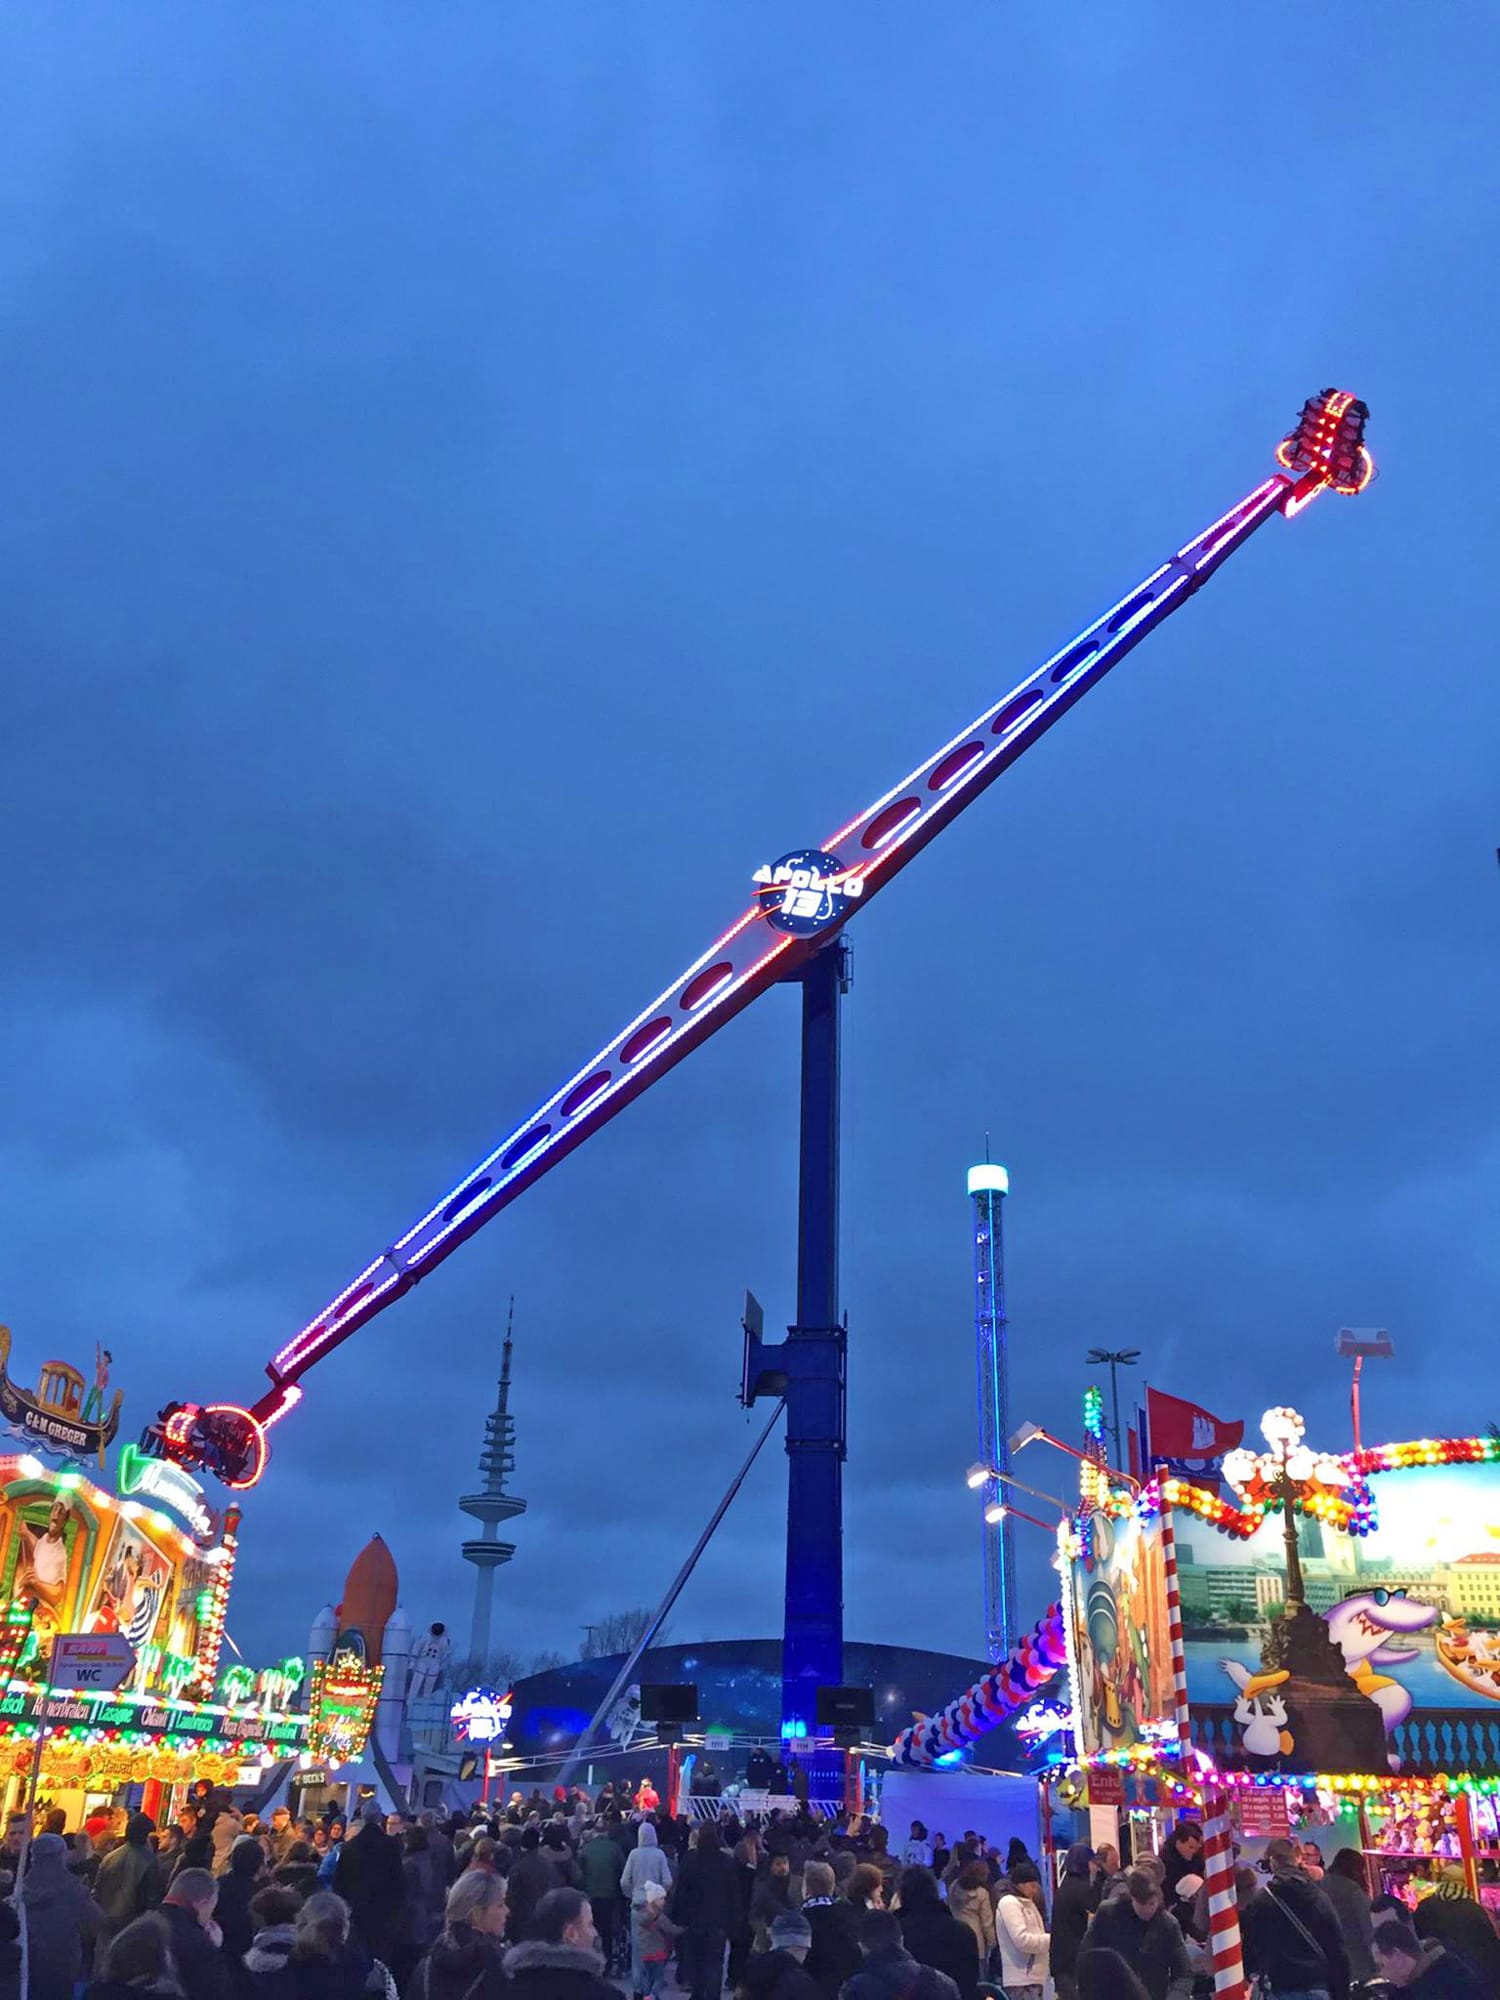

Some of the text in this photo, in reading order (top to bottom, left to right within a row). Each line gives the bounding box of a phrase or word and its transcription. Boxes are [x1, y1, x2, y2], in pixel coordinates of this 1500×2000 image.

[752, 862, 865, 898] APOLLO
[781, 889, 823, 918] 13
[25, 1411, 87, 1446] C&M GREGER
[76, 1669, 102, 1682] WC
